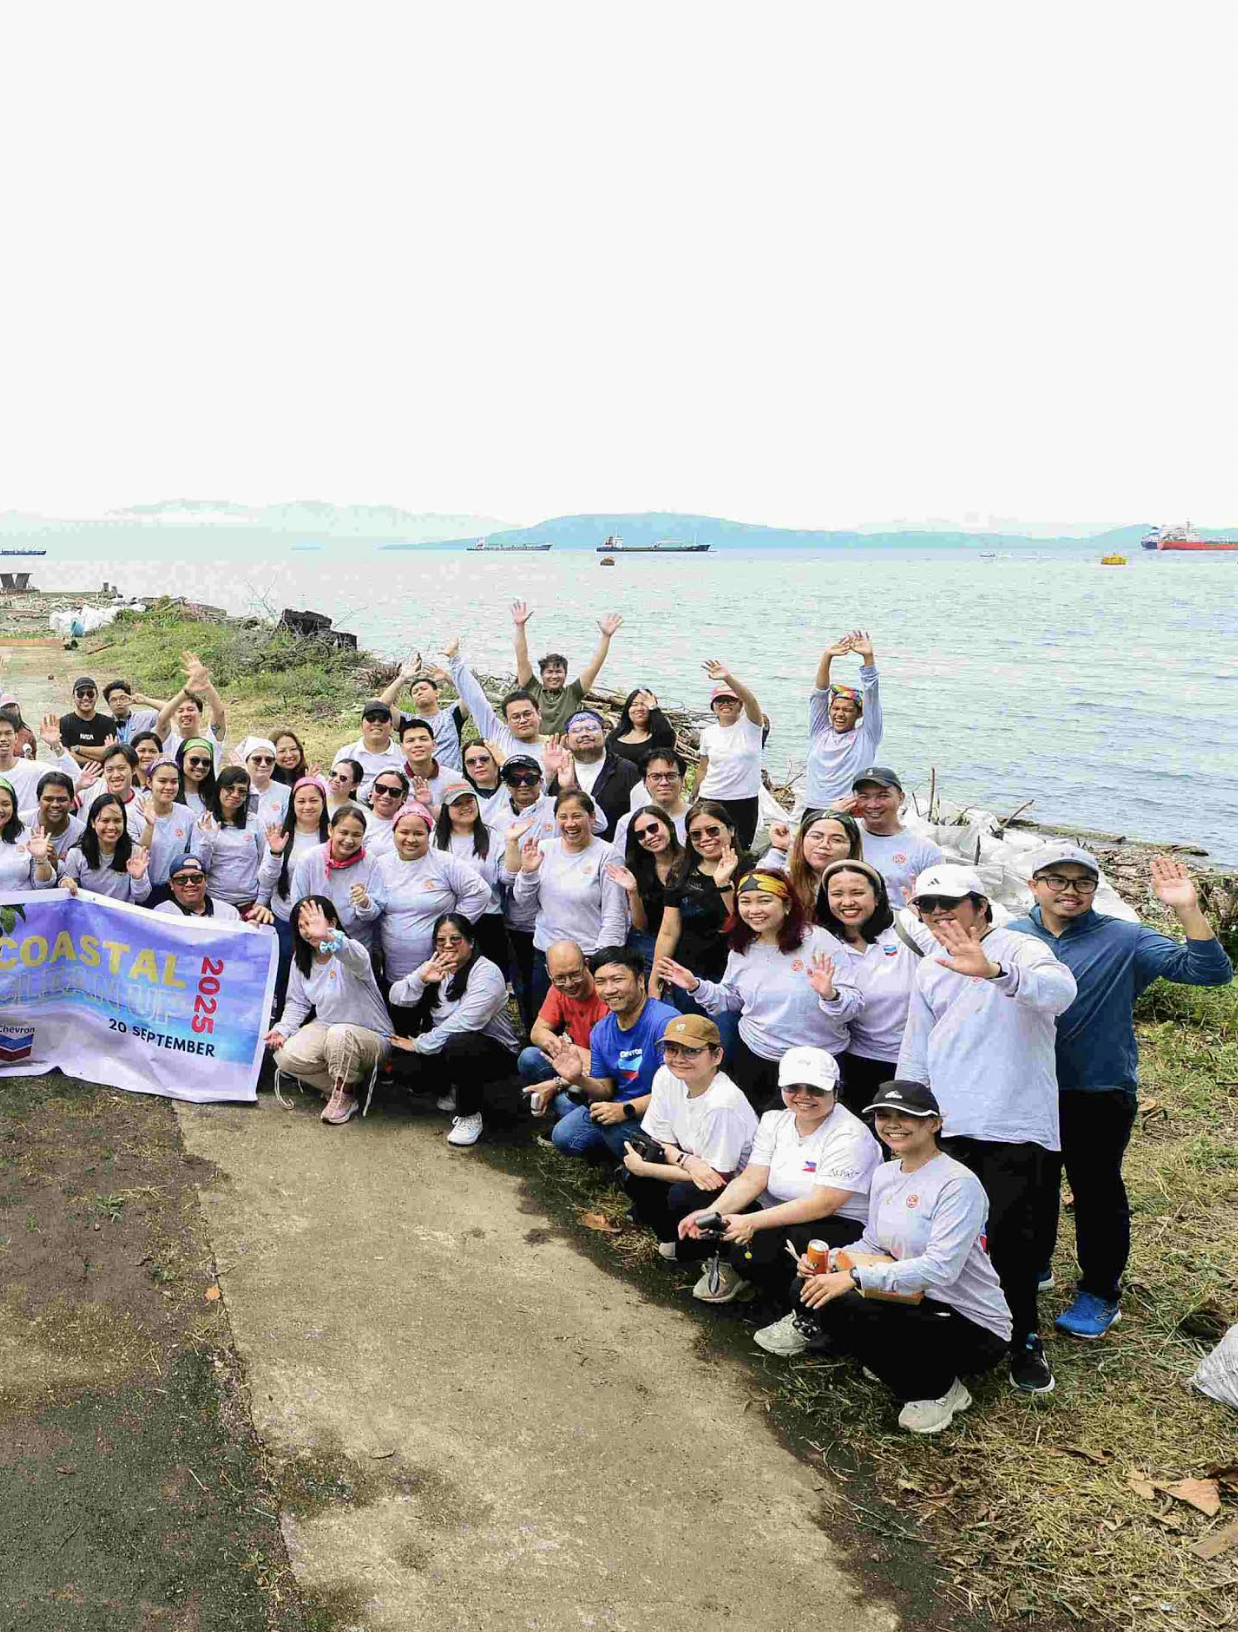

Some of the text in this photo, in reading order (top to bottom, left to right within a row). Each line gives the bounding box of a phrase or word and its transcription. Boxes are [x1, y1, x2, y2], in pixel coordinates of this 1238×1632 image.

[192, 956, 224, 1034] 2025
[108, 1018, 216, 1058] 20 SEPTEMBER
